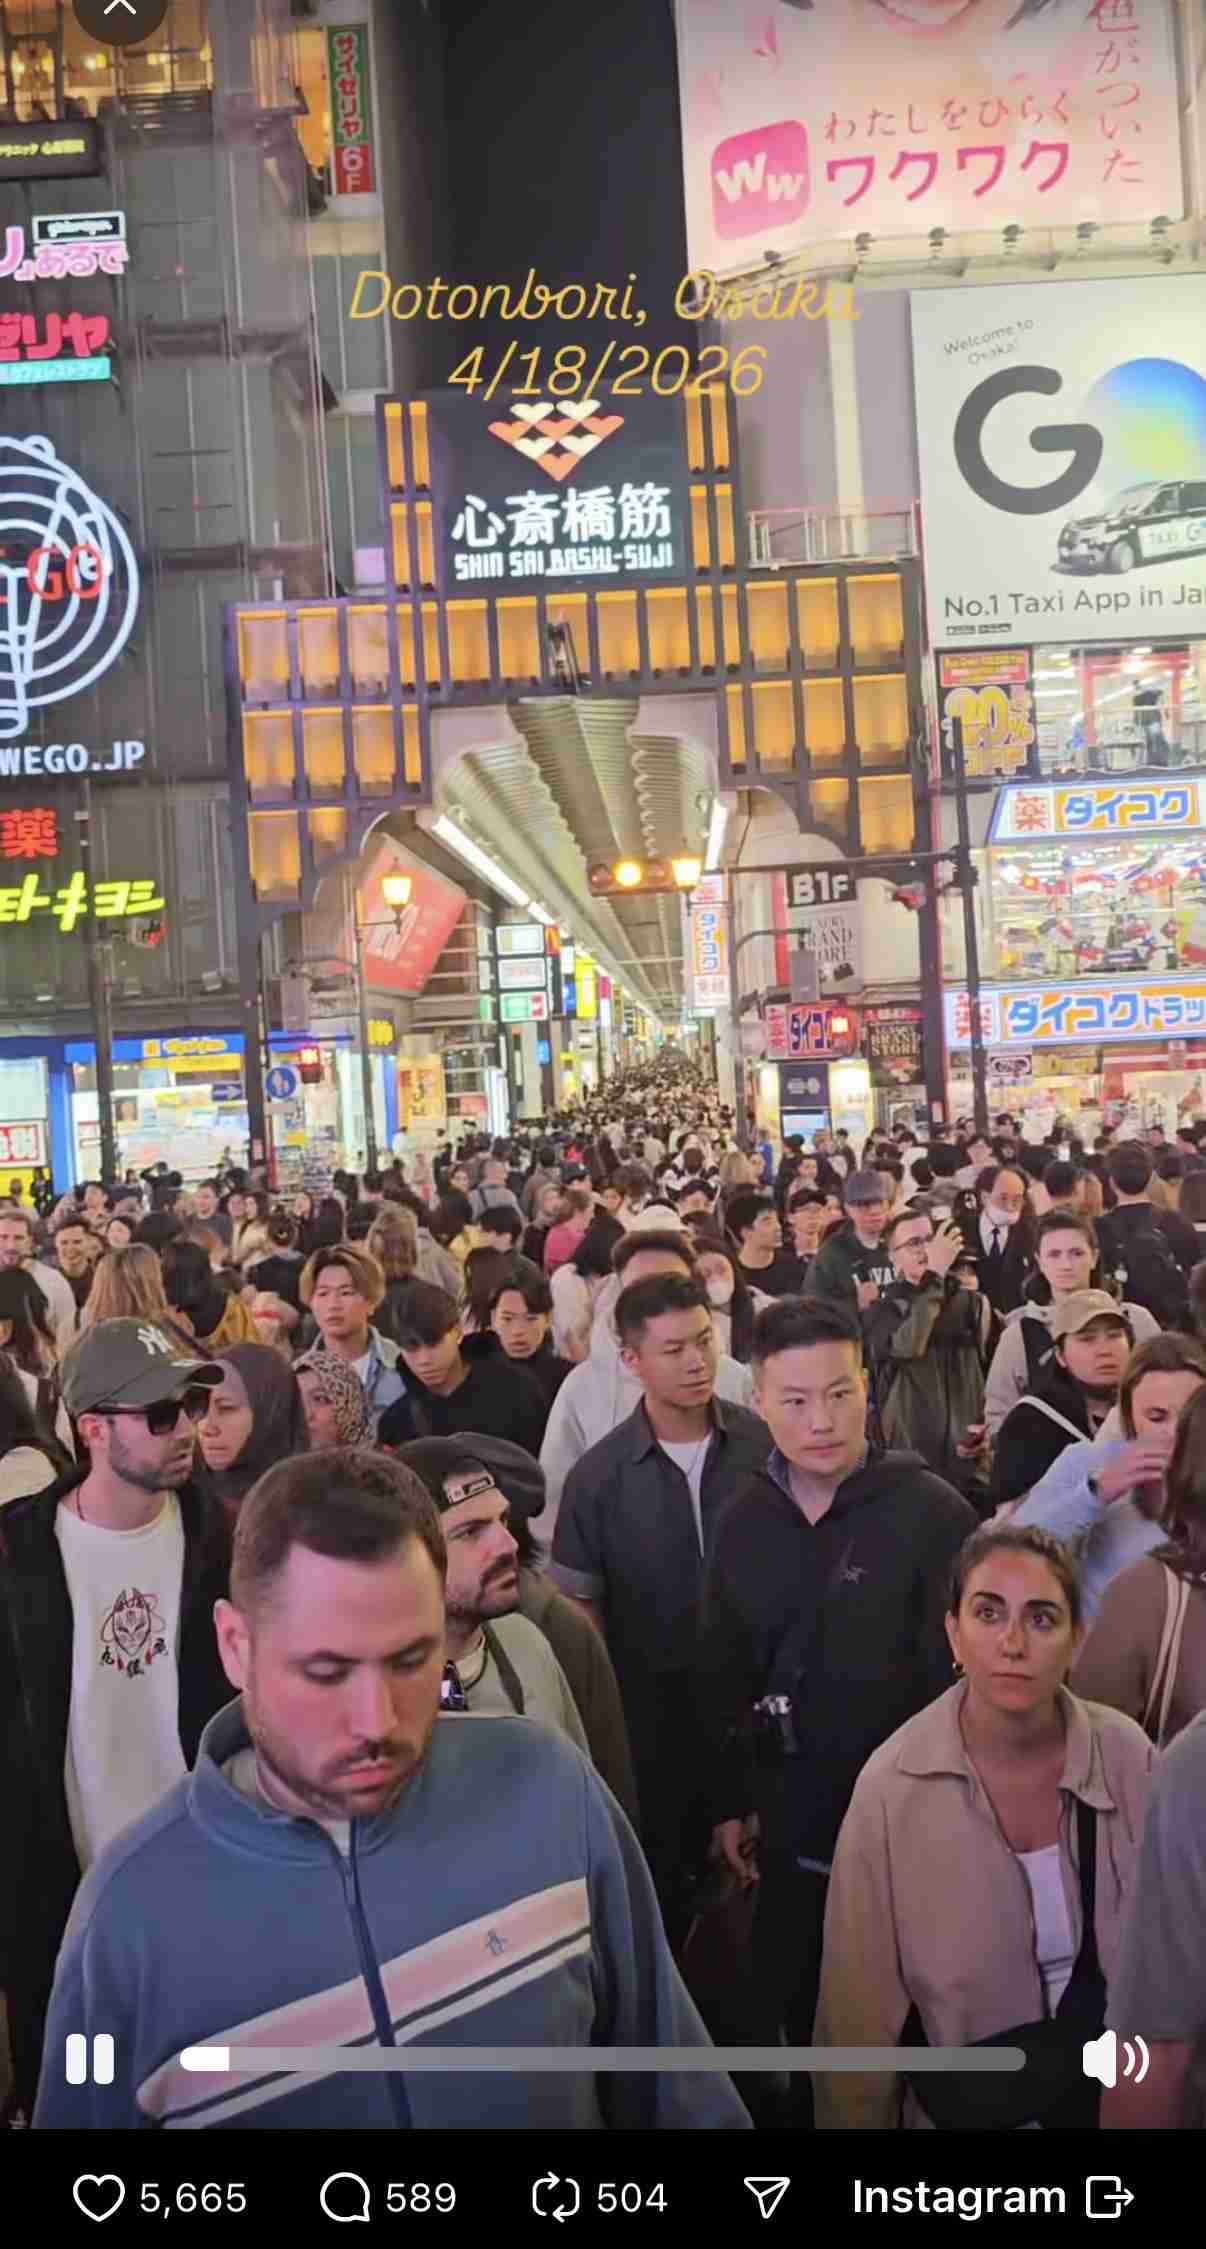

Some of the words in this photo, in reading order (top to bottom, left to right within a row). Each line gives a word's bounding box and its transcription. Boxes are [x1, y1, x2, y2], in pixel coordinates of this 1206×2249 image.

[824, 91, 1071, 144] わたしをひらく
[825, 140, 1070, 207] ワクワク
[943, 325, 1015, 354] Welcome
[451, 481, 672, 548] 心斎橋筋
[944, 595, 1000, 618] No.1
[1008, 589, 1065, 616] Taxi
[1074, 586, 1131, 614] App
[1140, 585, 1163, 607] in
[1065, 789, 1190, 827] ダイコク
[793, 871, 849, 905] B1F
